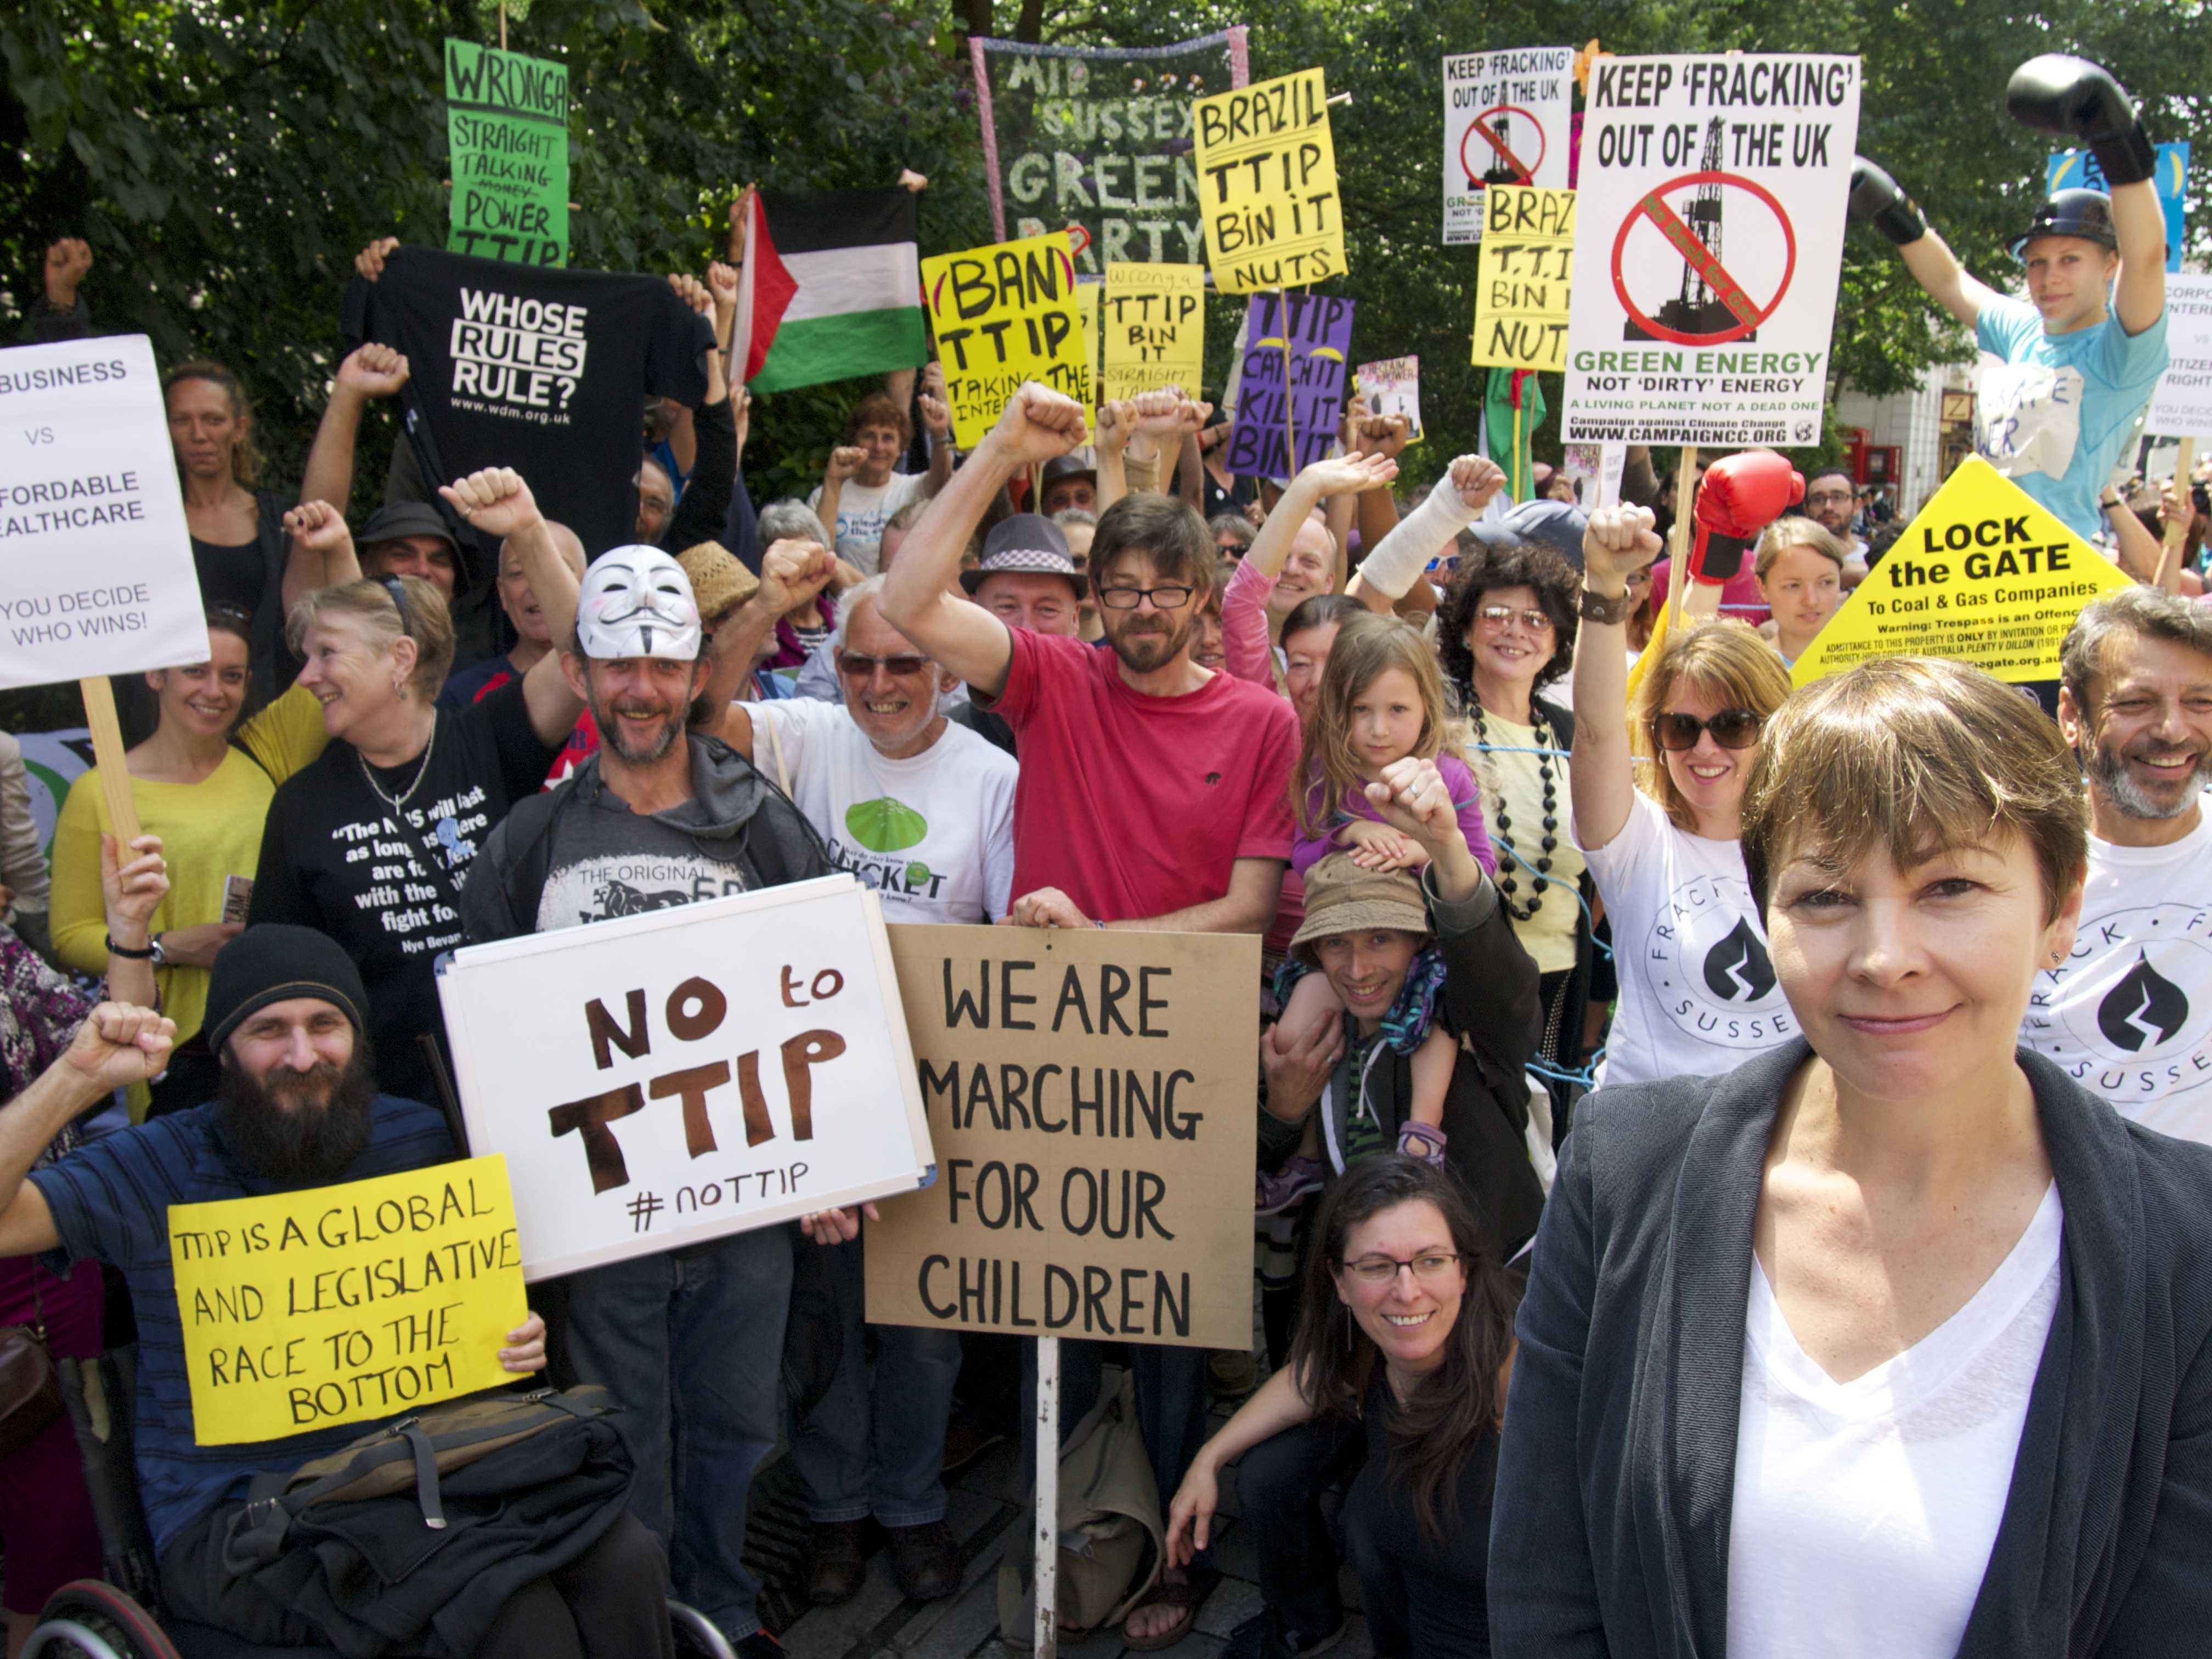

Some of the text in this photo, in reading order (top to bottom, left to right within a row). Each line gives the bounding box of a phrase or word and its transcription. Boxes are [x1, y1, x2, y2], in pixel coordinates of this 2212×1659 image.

[450, 44, 566, 117] WRONGA
[1447, 58, 1485, 81] KEEP
[1595, 62, 1853, 108] KEEP 'FRACKING'
[1453, 80, 1560, 108] OUT OF THE UK
[1200, 78, 1324, 149] BRAZIL
[1598, 123, 1832, 167] OUT OF THE UK
[1009, 151, 1200, 209] GREEN
[1205, 143, 1321, 204] TTIP
[465, 190, 550, 237] POWER
[456, 229, 560, 267] TTIP
[1642, 194, 1757, 326] No Dash for Gas
[1235, 247, 1331, 289] NUTS
[460, 287, 588, 339] WHOSE
[1110, 294, 1197, 324] TTIP
[1491, 280, 1547, 309] BIN
[1128, 325, 1176, 346] BIN
[1256, 292, 1344, 344] TTIP
[458, 323, 579, 371] RULES
[939, 311, 1070, 370] TTIP
[1141, 345, 1166, 362] IT
[0, 359, 126, 394] BUSINESS
[1046, 363, 1090, 391] THE
[1107, 368, 1192, 382] STRAIGHT
[1316, 359, 1342, 388] IT
[1574, 351, 1823, 374] GREEN ENERGY
[452, 358, 577, 409] RULE?
[1587, 376, 1805, 393] NOT 'DIRTY' ENERGY
[450, 397, 571, 425] www.wdm.org.uk
[1238, 387, 1338, 430] KILL IT
[1570, 399, 1820, 412] A LIVING PLANET NOT A DEAD ONE
[1570, 415, 1786, 429] Campaign against Climate Change
[24, 427, 55, 446] VS
[1570, 426, 1787, 443] WWW.CAMPAIGNCC.ORG
[1924, 515, 2033, 554] LOCK
[1889, 543, 2072, 588] the GATE
[1, 583, 150, 622] YOU DECIDE
[1867, 582, 2098, 616] To Coal & Gas Companies
[11, 611, 148, 647] WHO WINS!
[1826, 640, 1872, 653] ADMITTANCE
[1874, 640, 1883, 649] TO
[1886, 638, 1903, 648] THIS
[1904, 635, 1944, 646] PROPERTY
[1947, 634, 1954, 644] IS
[1957, 632, 1984, 642] ONLY
[1987, 631, 1997, 640] BY
[2000, 627, 2044, 639] INVITATION
[2047, 625, 2058, 635] OR
[1877, 622, 1932, 634] Warning:
[1935, 617, 1994, 629] Trespass
[1998, 614, 2010, 624] is
[2014, 613, 2030, 622] an
[1922, 641, 1965, 657] AUSTRALIA
[1966, 641, 1996, 653] PLENTY
[1998, 641, 2004, 651] V
[2006, 639, 2035, 651] DILLON
[427, 798, 458, 821] will
[456, 785, 487, 810] last
[346, 845, 370, 863] as
[371, 865, 405, 881] are
[578, 865, 707, 885] THE ORIGINAL
[354, 882, 437, 909] with the
[381, 907, 431, 933] fight
[401, 939, 425, 954] Nye
[943, 957, 1172, 1038] WE ARE
[585, 964, 845, 1070] NO to
[546, 1029, 847, 1196] TTIP
[918, 1058, 1204, 1141] MARCHING
[242, 1222, 271, 1254] IS
[279, 1216, 309, 1251] A
[317, 1177, 495, 1248] GLOBAL
[947, 1159, 1175, 1240] FOR OUR
[195, 1228, 522, 1327] AND LEGISLATIVE
[918, 1254, 1191, 1338] CHILDREN
[208, 1301, 465, 1387] RACE TO THE
[287, 1351, 455, 1425] BOTTOM
